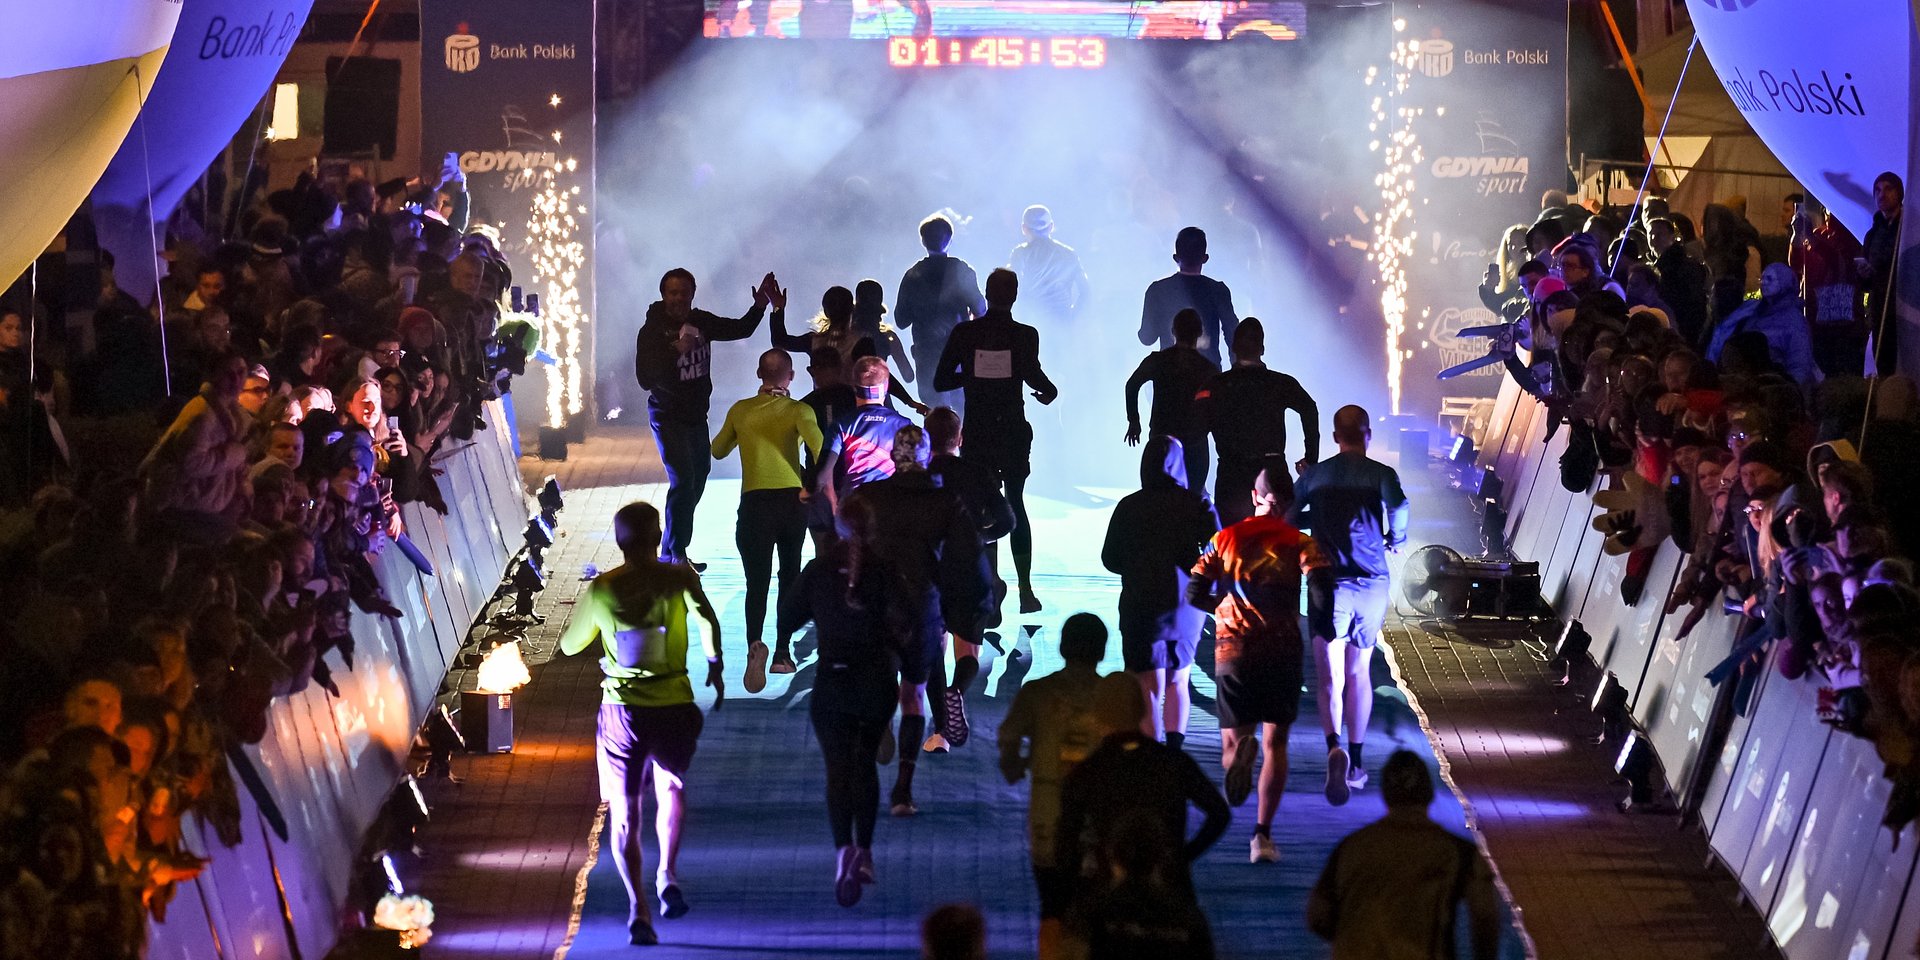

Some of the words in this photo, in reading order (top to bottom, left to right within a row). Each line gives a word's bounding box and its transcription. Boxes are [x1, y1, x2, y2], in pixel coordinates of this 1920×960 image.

[200, 10, 275, 60] Bank
[490, 43, 528, 60] Bank
[533, 43, 576, 60] Polski
[889, 37, 1105, 67] 01:45:53
[1463, 49, 1501, 65] Bank
[1506, 49, 1549, 65] Polski
[1715, 66, 1769, 112] ank
[1758, 68, 1865, 116] Polski
[459, 150, 556, 174] GDYNIA
[1431, 156, 1529, 178] GDYNIA
[1477, 174, 1528, 197] sport
